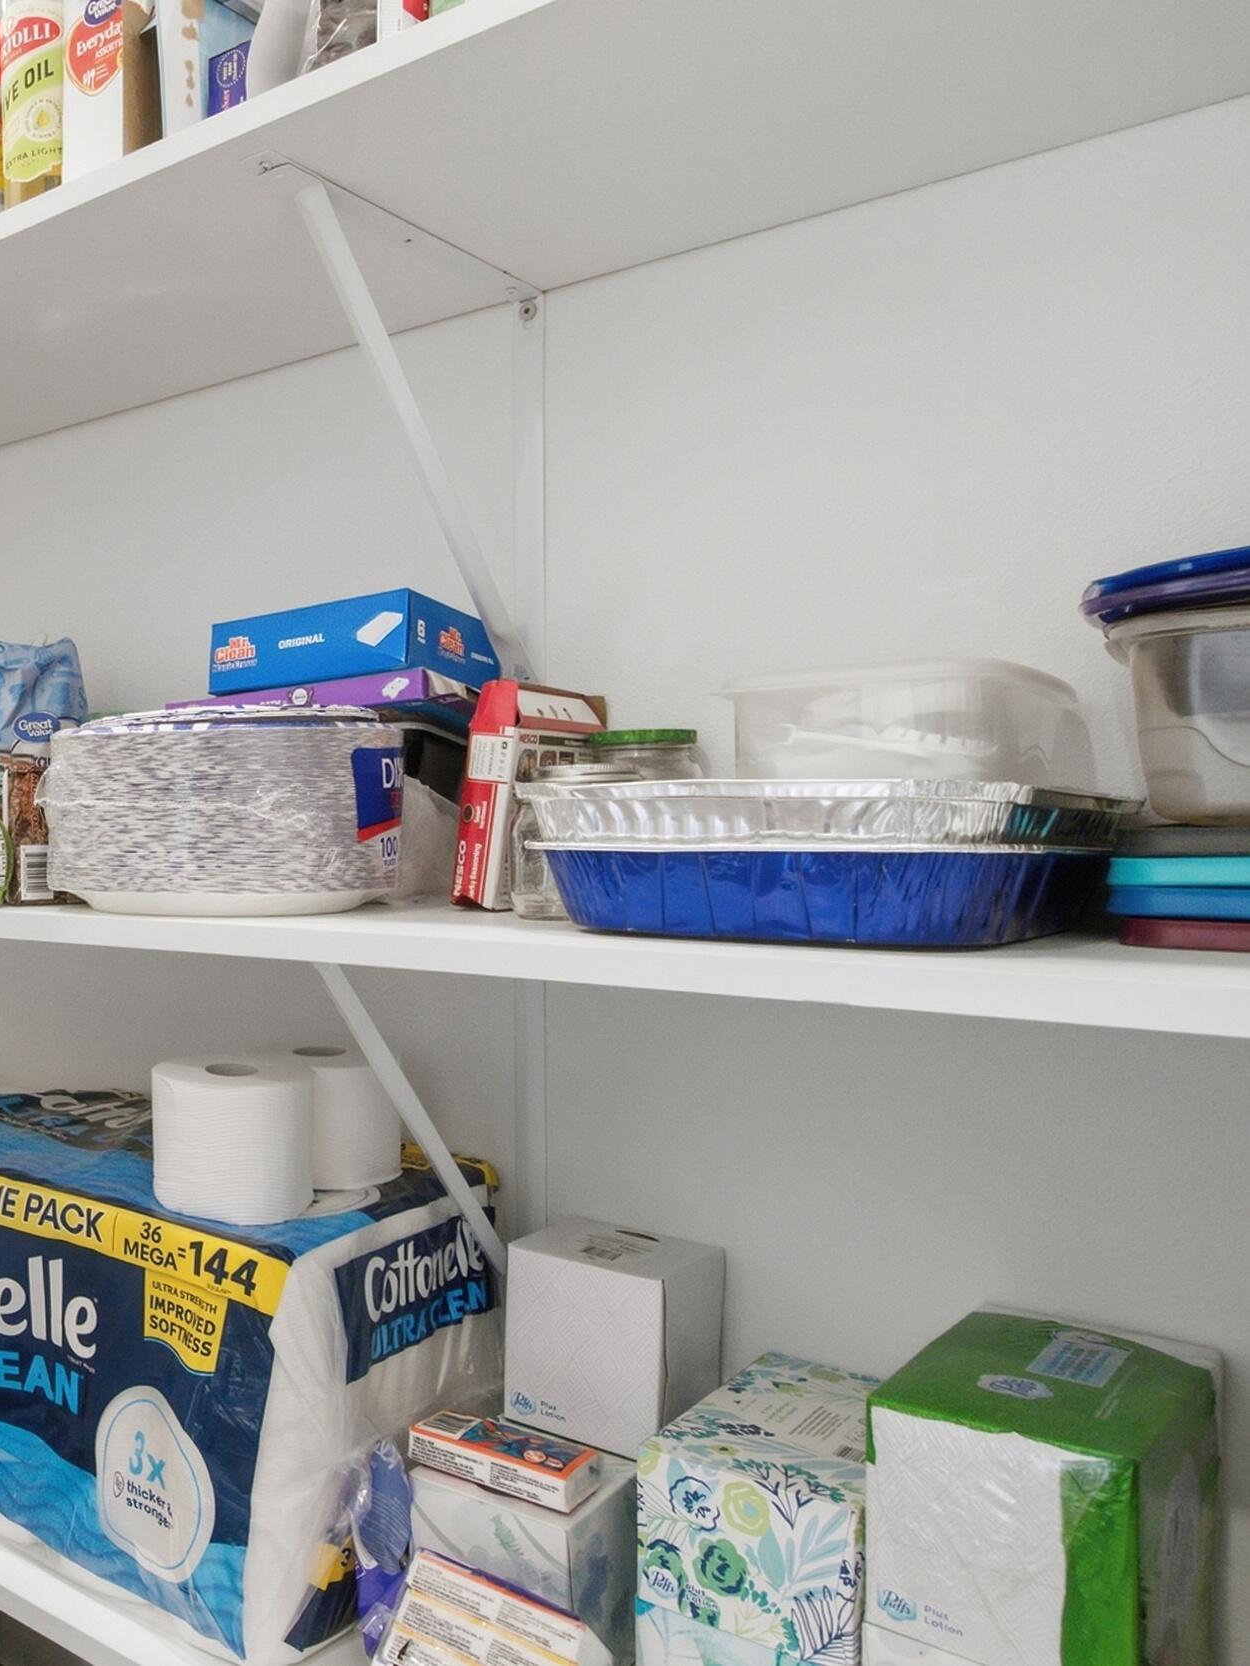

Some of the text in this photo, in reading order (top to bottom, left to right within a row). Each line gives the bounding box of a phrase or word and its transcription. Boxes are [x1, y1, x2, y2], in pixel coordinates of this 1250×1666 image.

[24, 59, 54, 89] OIL
[214, 645, 255, 664] Clean
[278, 633, 325, 650] ORIGINAL
[18, 719, 54, 732] Great
[380, 836, 398, 858] 100
[470, 842, 483, 880] Seasoning
[453, 840, 467, 897] NESCO
[23, 1192, 105, 1243] PACK
[140, 1222, 162, 1244] 36
[123, 1238, 178, 1271] MEGA
[190, 1241, 259, 1297] 144
[152, 1280, 179, 1297] ULTRA
[149, 1294, 216, 1336] IMPROVED
[149, 1315, 213, 1357] SOFTNESS
[371, 1310, 426, 1359] ULTRA
[126, 1479, 165, 1510] thicker
[651, 1571, 674, 1593] Puffs
[882, 1588, 911, 1614] Puffs
[924, 1615, 964, 1637] Lotion
